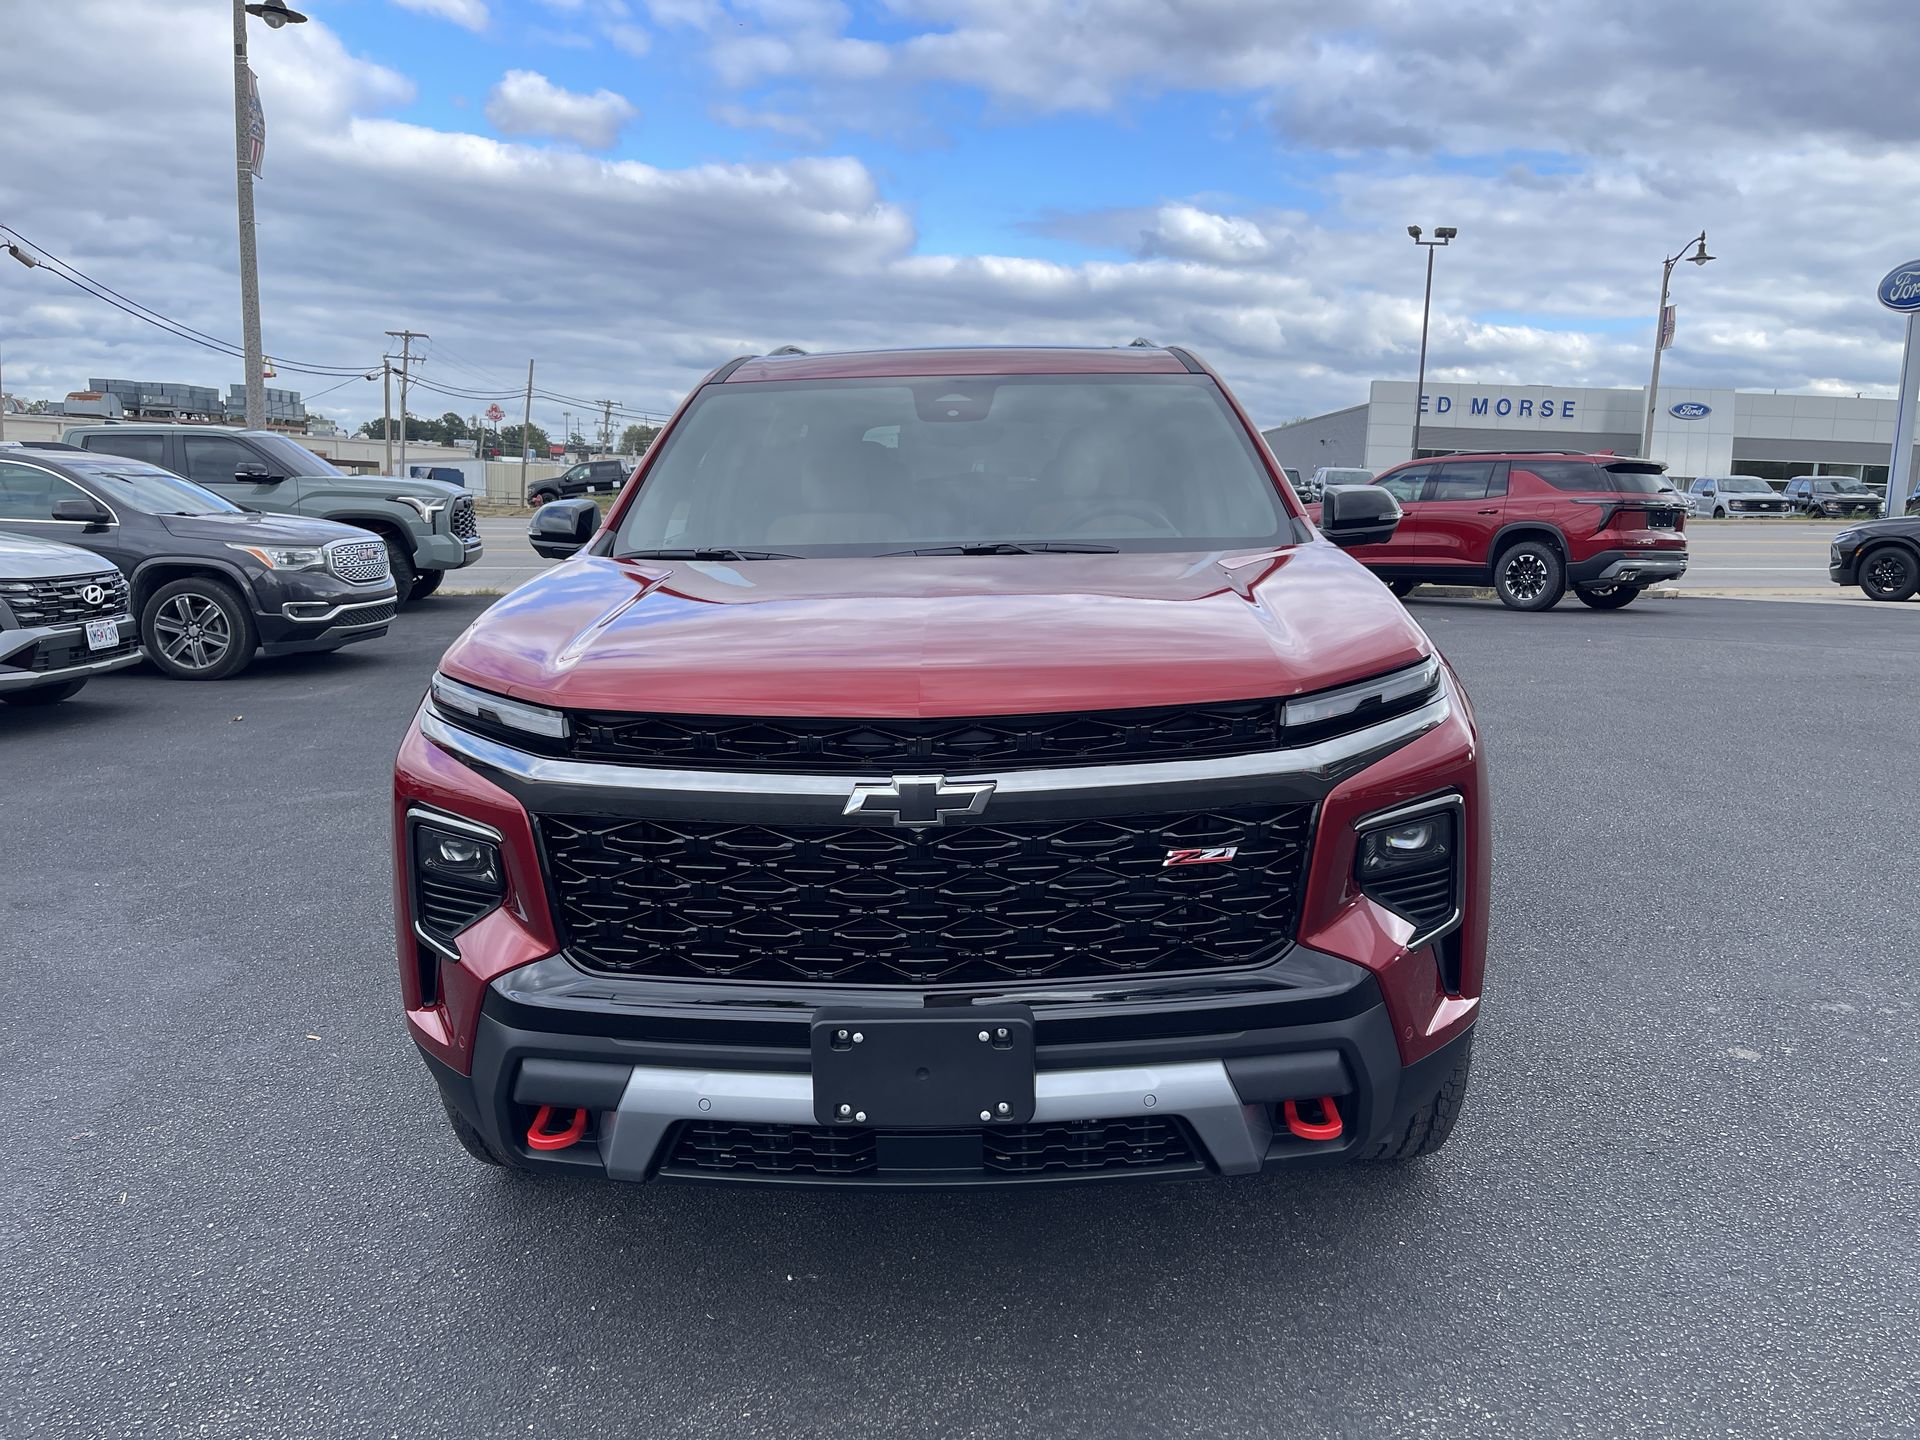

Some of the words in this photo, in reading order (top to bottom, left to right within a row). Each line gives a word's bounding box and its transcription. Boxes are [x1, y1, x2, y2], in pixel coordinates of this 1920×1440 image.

[1890, 271, 1920, 301] For
[1418, 395, 1452, 413] ED
[1471, 397, 1576, 418] MORSE
[1680, 404, 1704, 415] Ford
[357, 548, 379, 560] GMC
[1162, 846, 1238, 866] Z71
